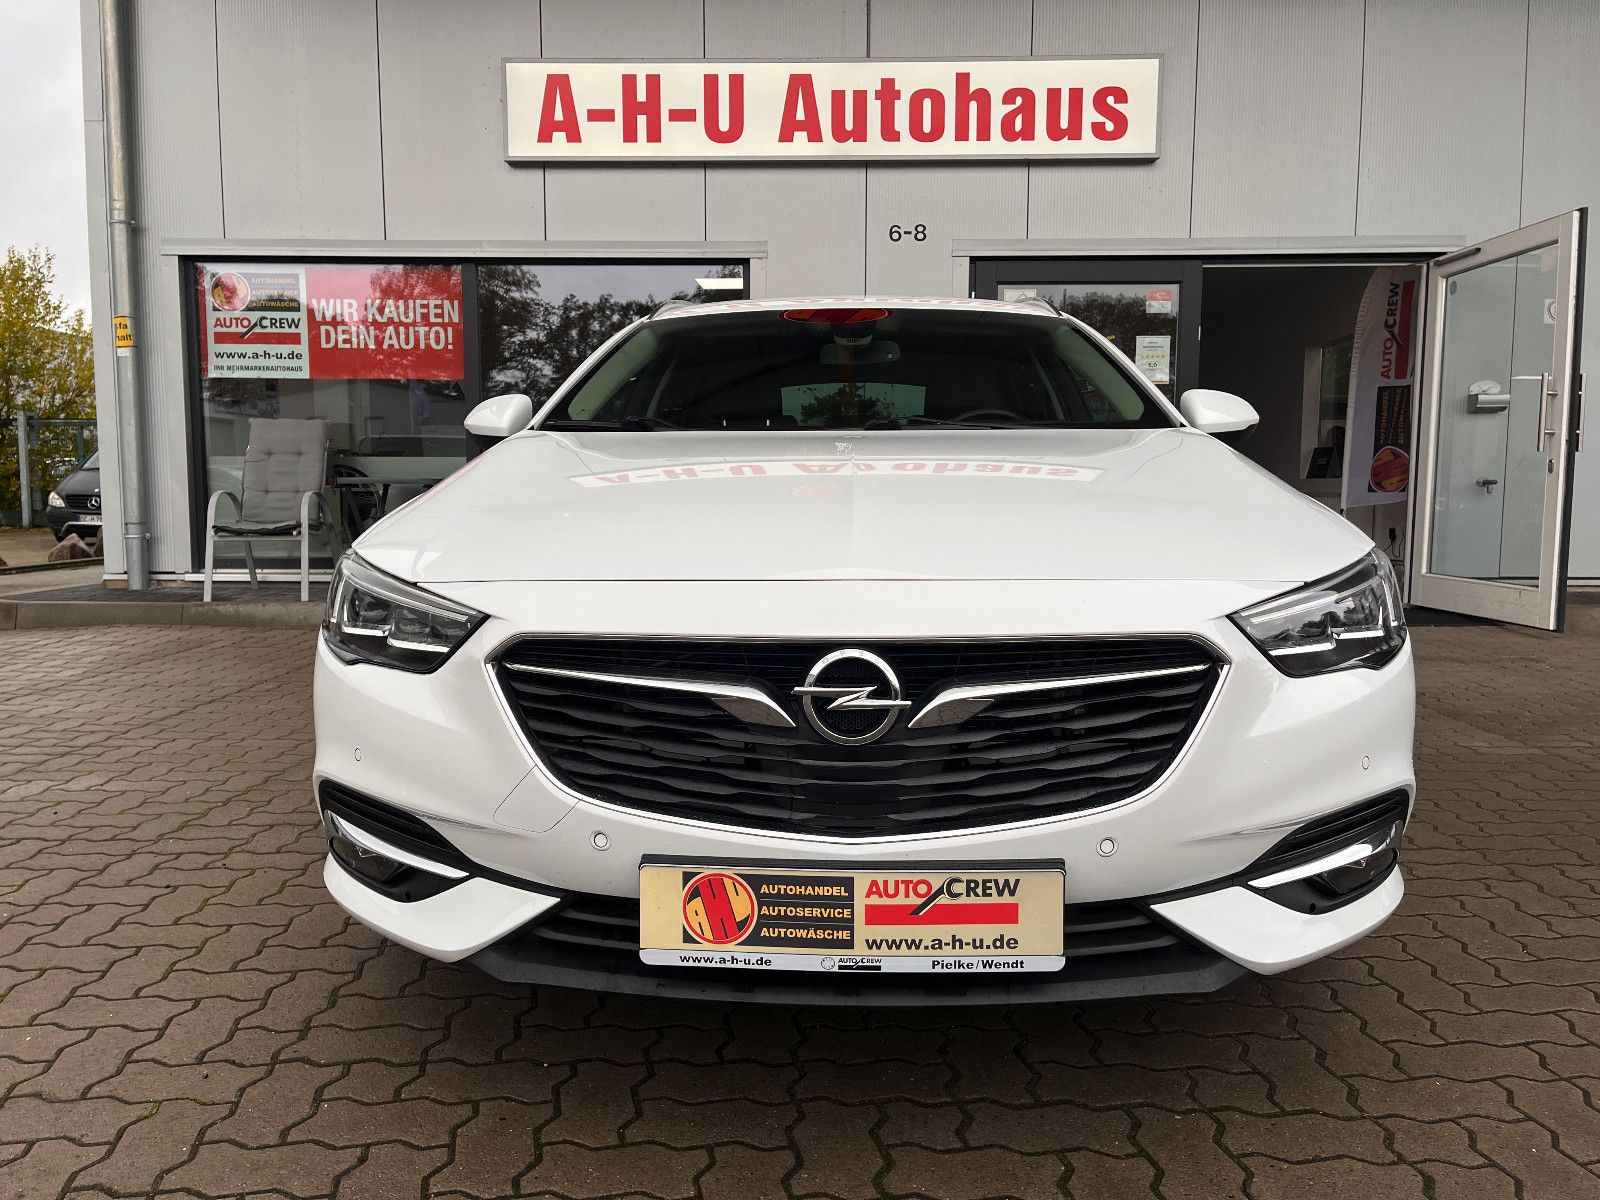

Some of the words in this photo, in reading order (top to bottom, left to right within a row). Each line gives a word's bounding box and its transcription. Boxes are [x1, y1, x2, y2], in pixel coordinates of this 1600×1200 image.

[536, 73, 744, 144] A-H-U
[777, 72, 1129, 144] Autohaus
[888, 224, 928, 243] 6-8
[252, 300, 299, 308] AUTOWÄSCHE
[312, 298, 358, 322] WIR
[366, 299, 459, 323] KAUFEN
[213, 317, 252, 329] AUTO
[320, 326, 375, 349] DEIN
[383, 327, 453, 350] AUTO!
[214, 350, 303, 360] www.a-h-u.de
[760, 884, 849, 897] AUTOHANDEL
[865, 879, 933, 899] AUTO
[760, 905, 852, 918] AUTOSERVICE
[760, 926, 851, 940] AUTOWÄSCHE
[864, 934, 1019, 951] www.a-h-u.de
[679, 955, 773, 967] www.a-h-u.de
